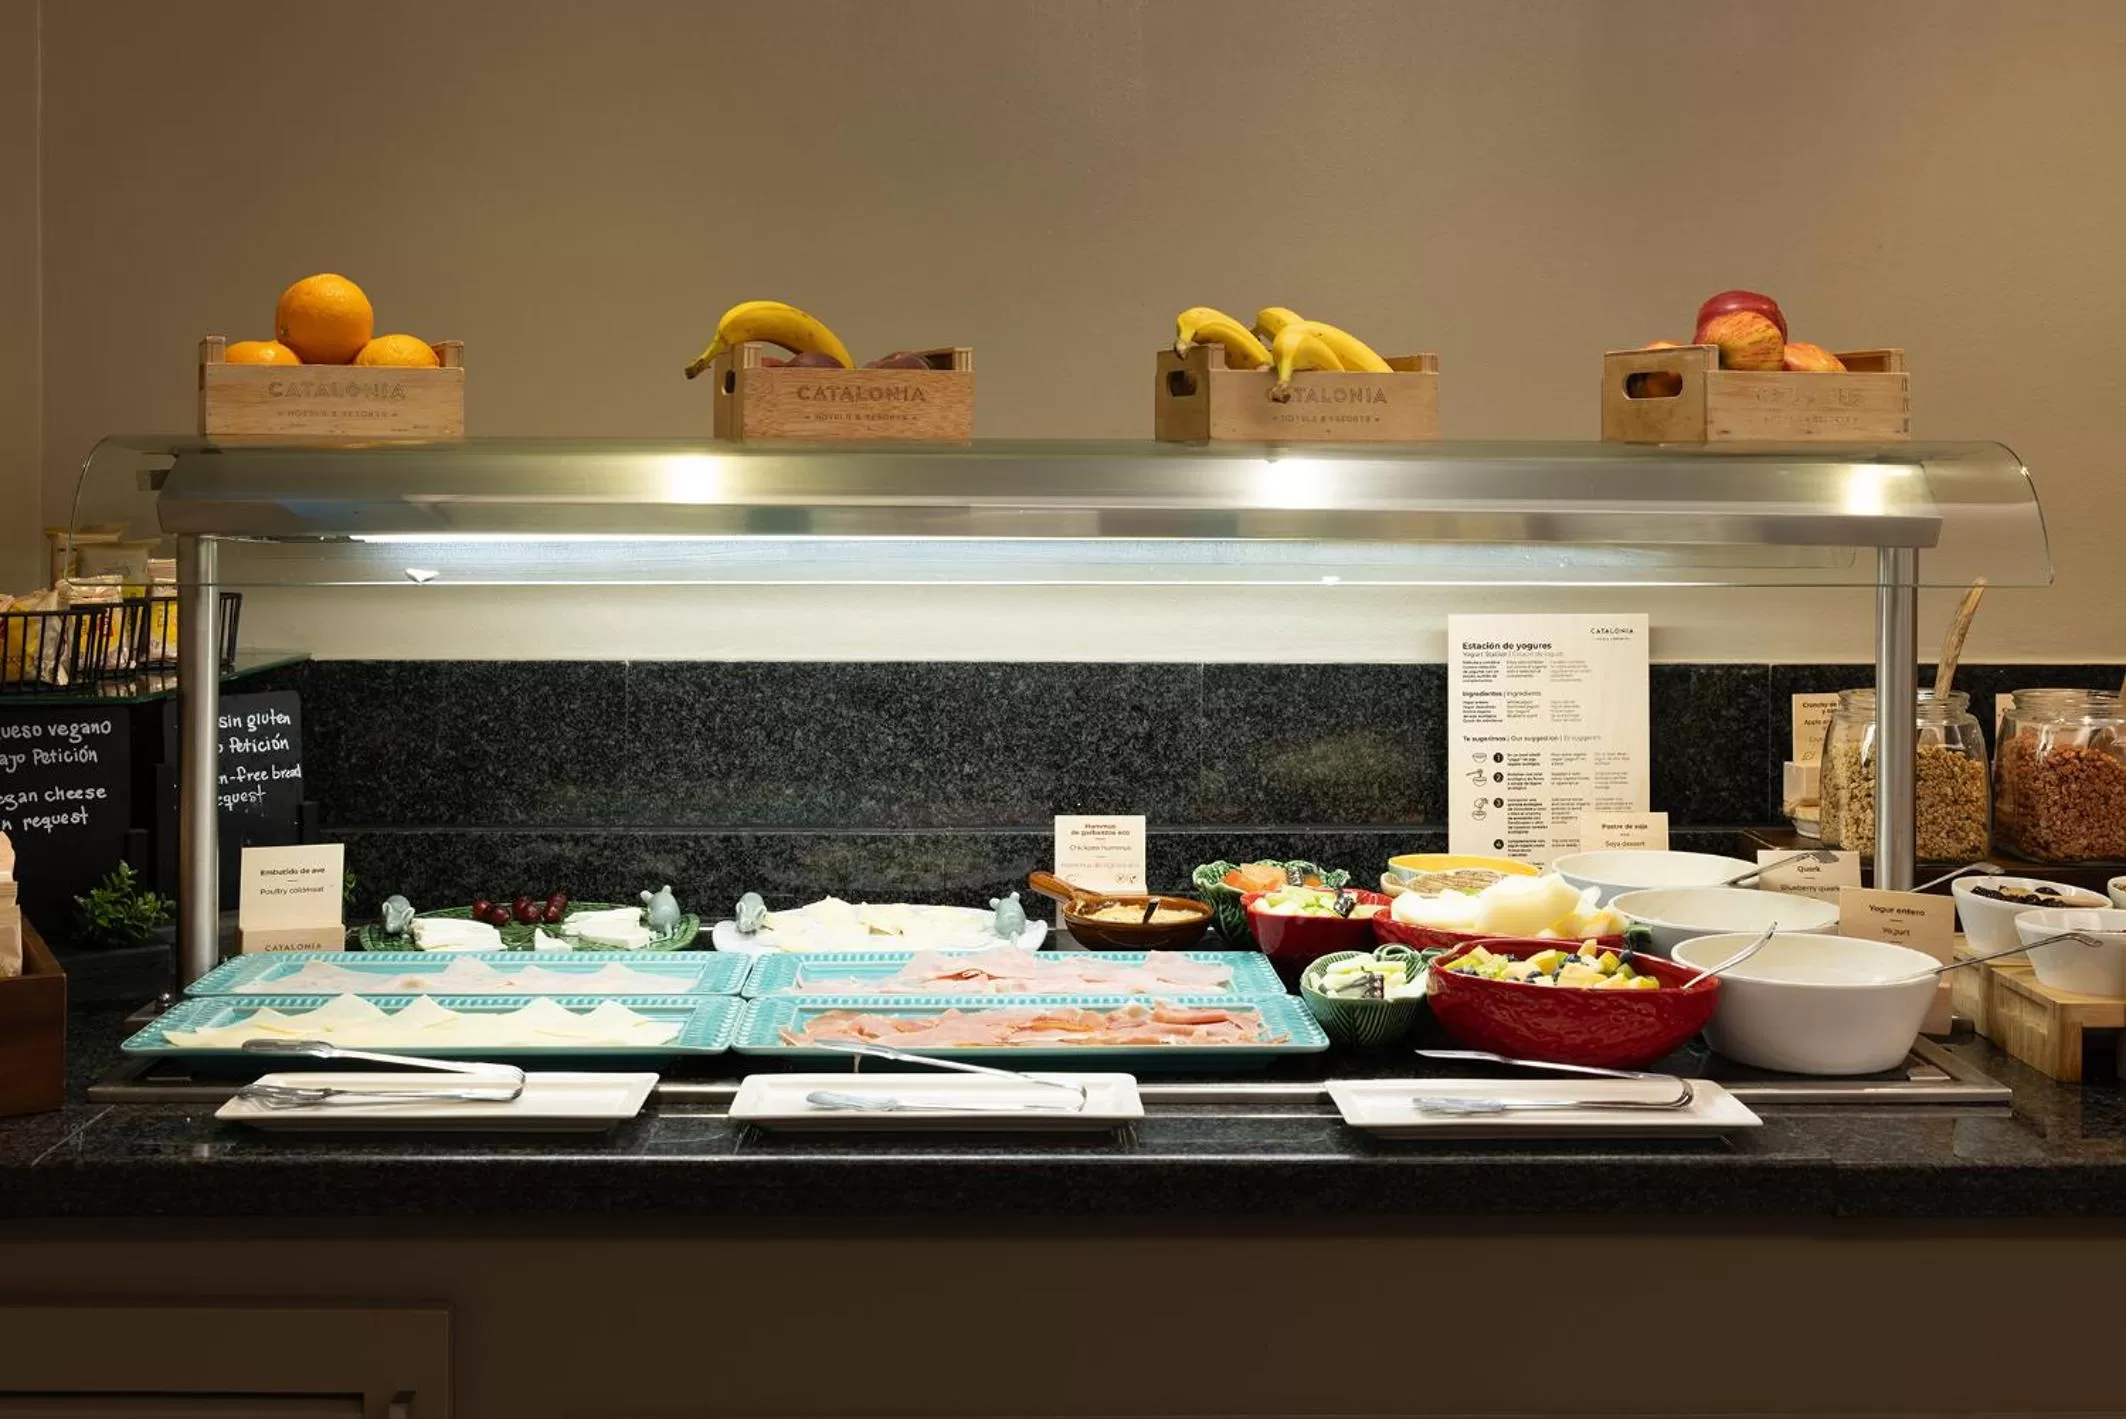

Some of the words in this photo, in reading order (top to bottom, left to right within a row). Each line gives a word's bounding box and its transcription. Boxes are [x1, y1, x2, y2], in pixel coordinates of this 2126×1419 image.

[267, 381, 408, 400] CATALONIA
[797, 384, 927, 402] CATALONIA
[1266, 387, 1388, 404] TALONIA
[1462, 641, 1501, 650] Estación
[1502, 642, 1514, 650] de
[1516, 642, 1552, 651] yogures
[219, 714, 242, 728] sin
[247, 708, 291, 732] gluten
[0, 725, 42, 739] ueso
[48, 720, 112, 744] vegano
[229, 732, 290, 754] Petición
[0, 753, 26, 774] ajo
[32, 745, 99, 767] Petición
[219, 766, 269, 785] n-free
[271, 763, 302, 780] bread
[44, 785, 108, 802] cheese
[218, 784, 267, 812] quest
[23, 804, 89, 834] request
[1081, 829, 1117, 837] garbanzos
[260, 868, 298, 876] Embutido
[260, 888, 287, 896] Poultry
[1869, 904, 1894, 914] Yogur
[1896, 908, 1926, 916] entero
[1882, 926, 1910, 936] Yogurt
[264, 943, 323, 952] CATALONIA
